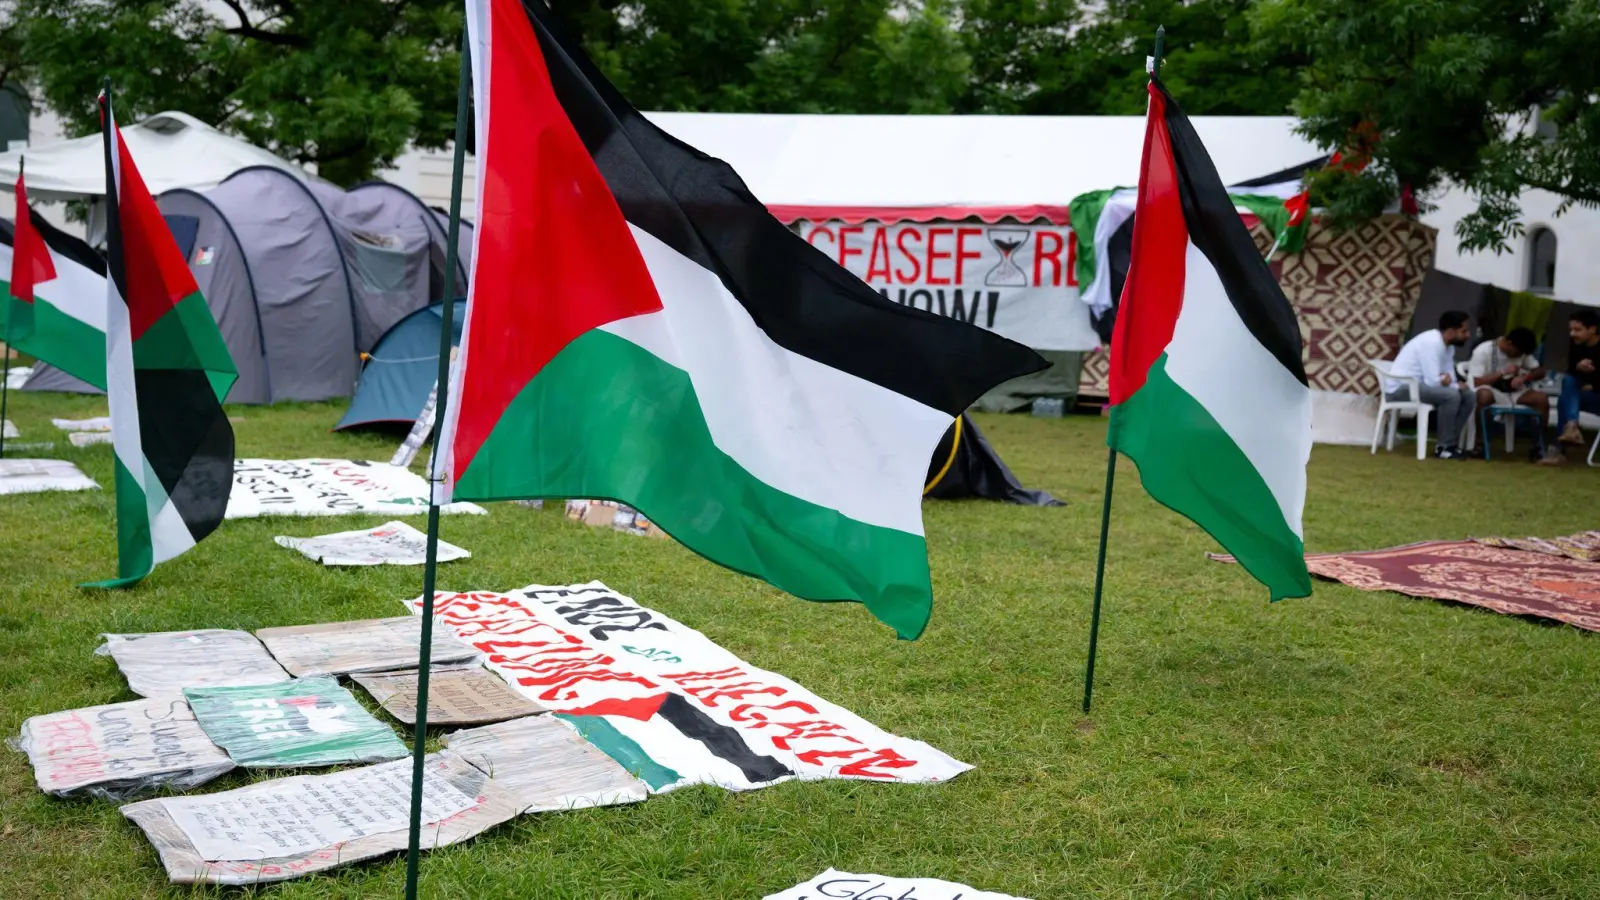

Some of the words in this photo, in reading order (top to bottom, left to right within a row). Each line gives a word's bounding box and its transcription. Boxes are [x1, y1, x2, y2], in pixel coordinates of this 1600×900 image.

[233, 698, 303, 740] FREE
[523, 588, 670, 641] ENDE
[657, 667, 918, 777] ILLEGALEN
